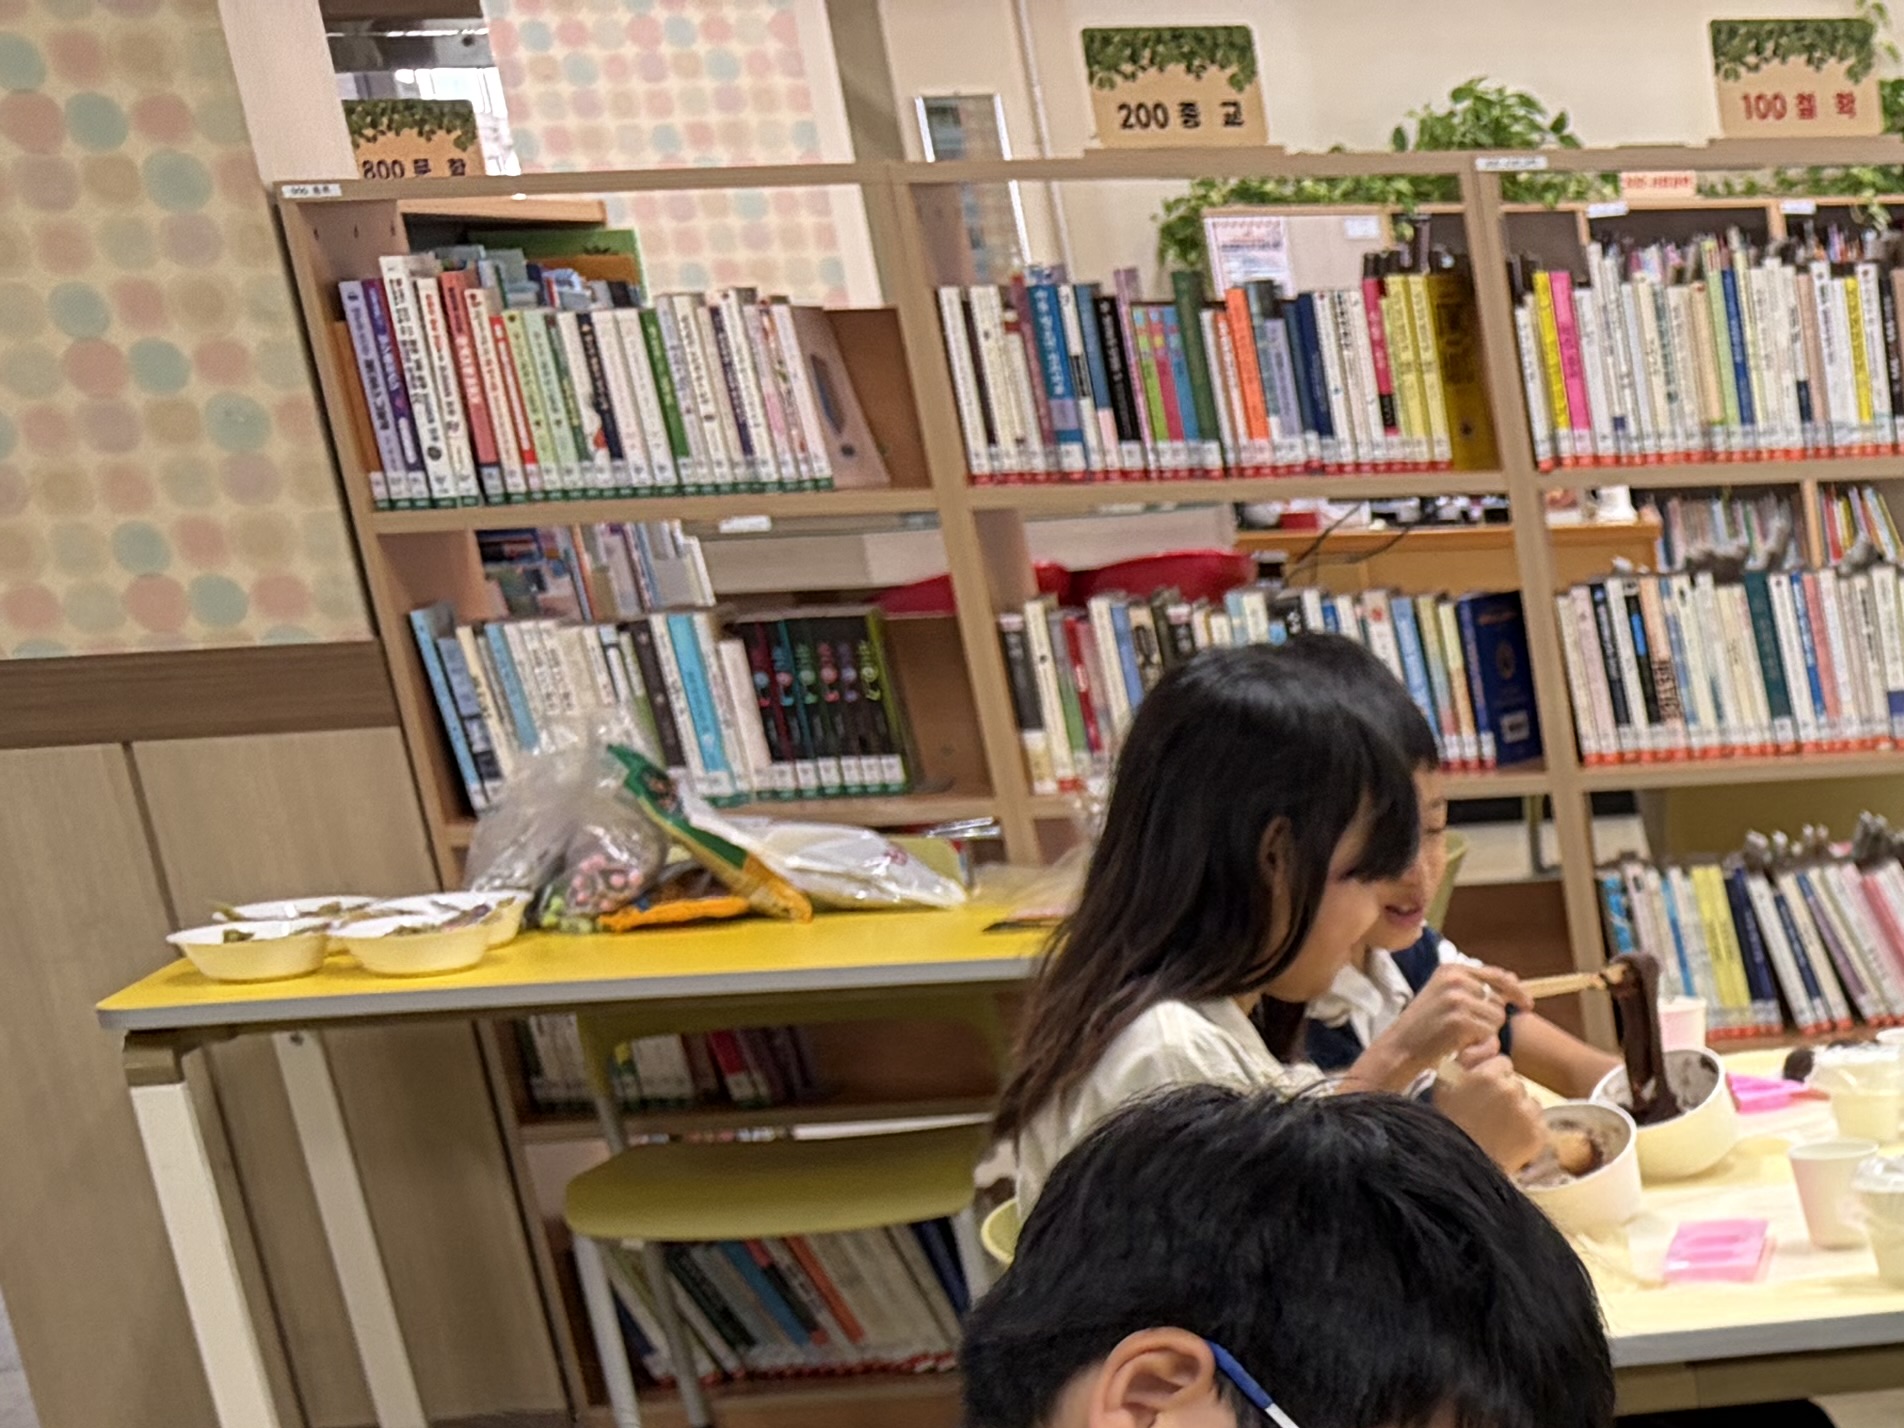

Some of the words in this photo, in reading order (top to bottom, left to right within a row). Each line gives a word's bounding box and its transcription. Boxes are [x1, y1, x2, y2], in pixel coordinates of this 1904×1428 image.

[1117, 102, 1169, 129] 200
[1178, 101, 1202, 129] 종
[1219, 99, 1245, 127] 교
[1741, 93, 1787, 120] 100
[362, 158, 405, 179] 800
